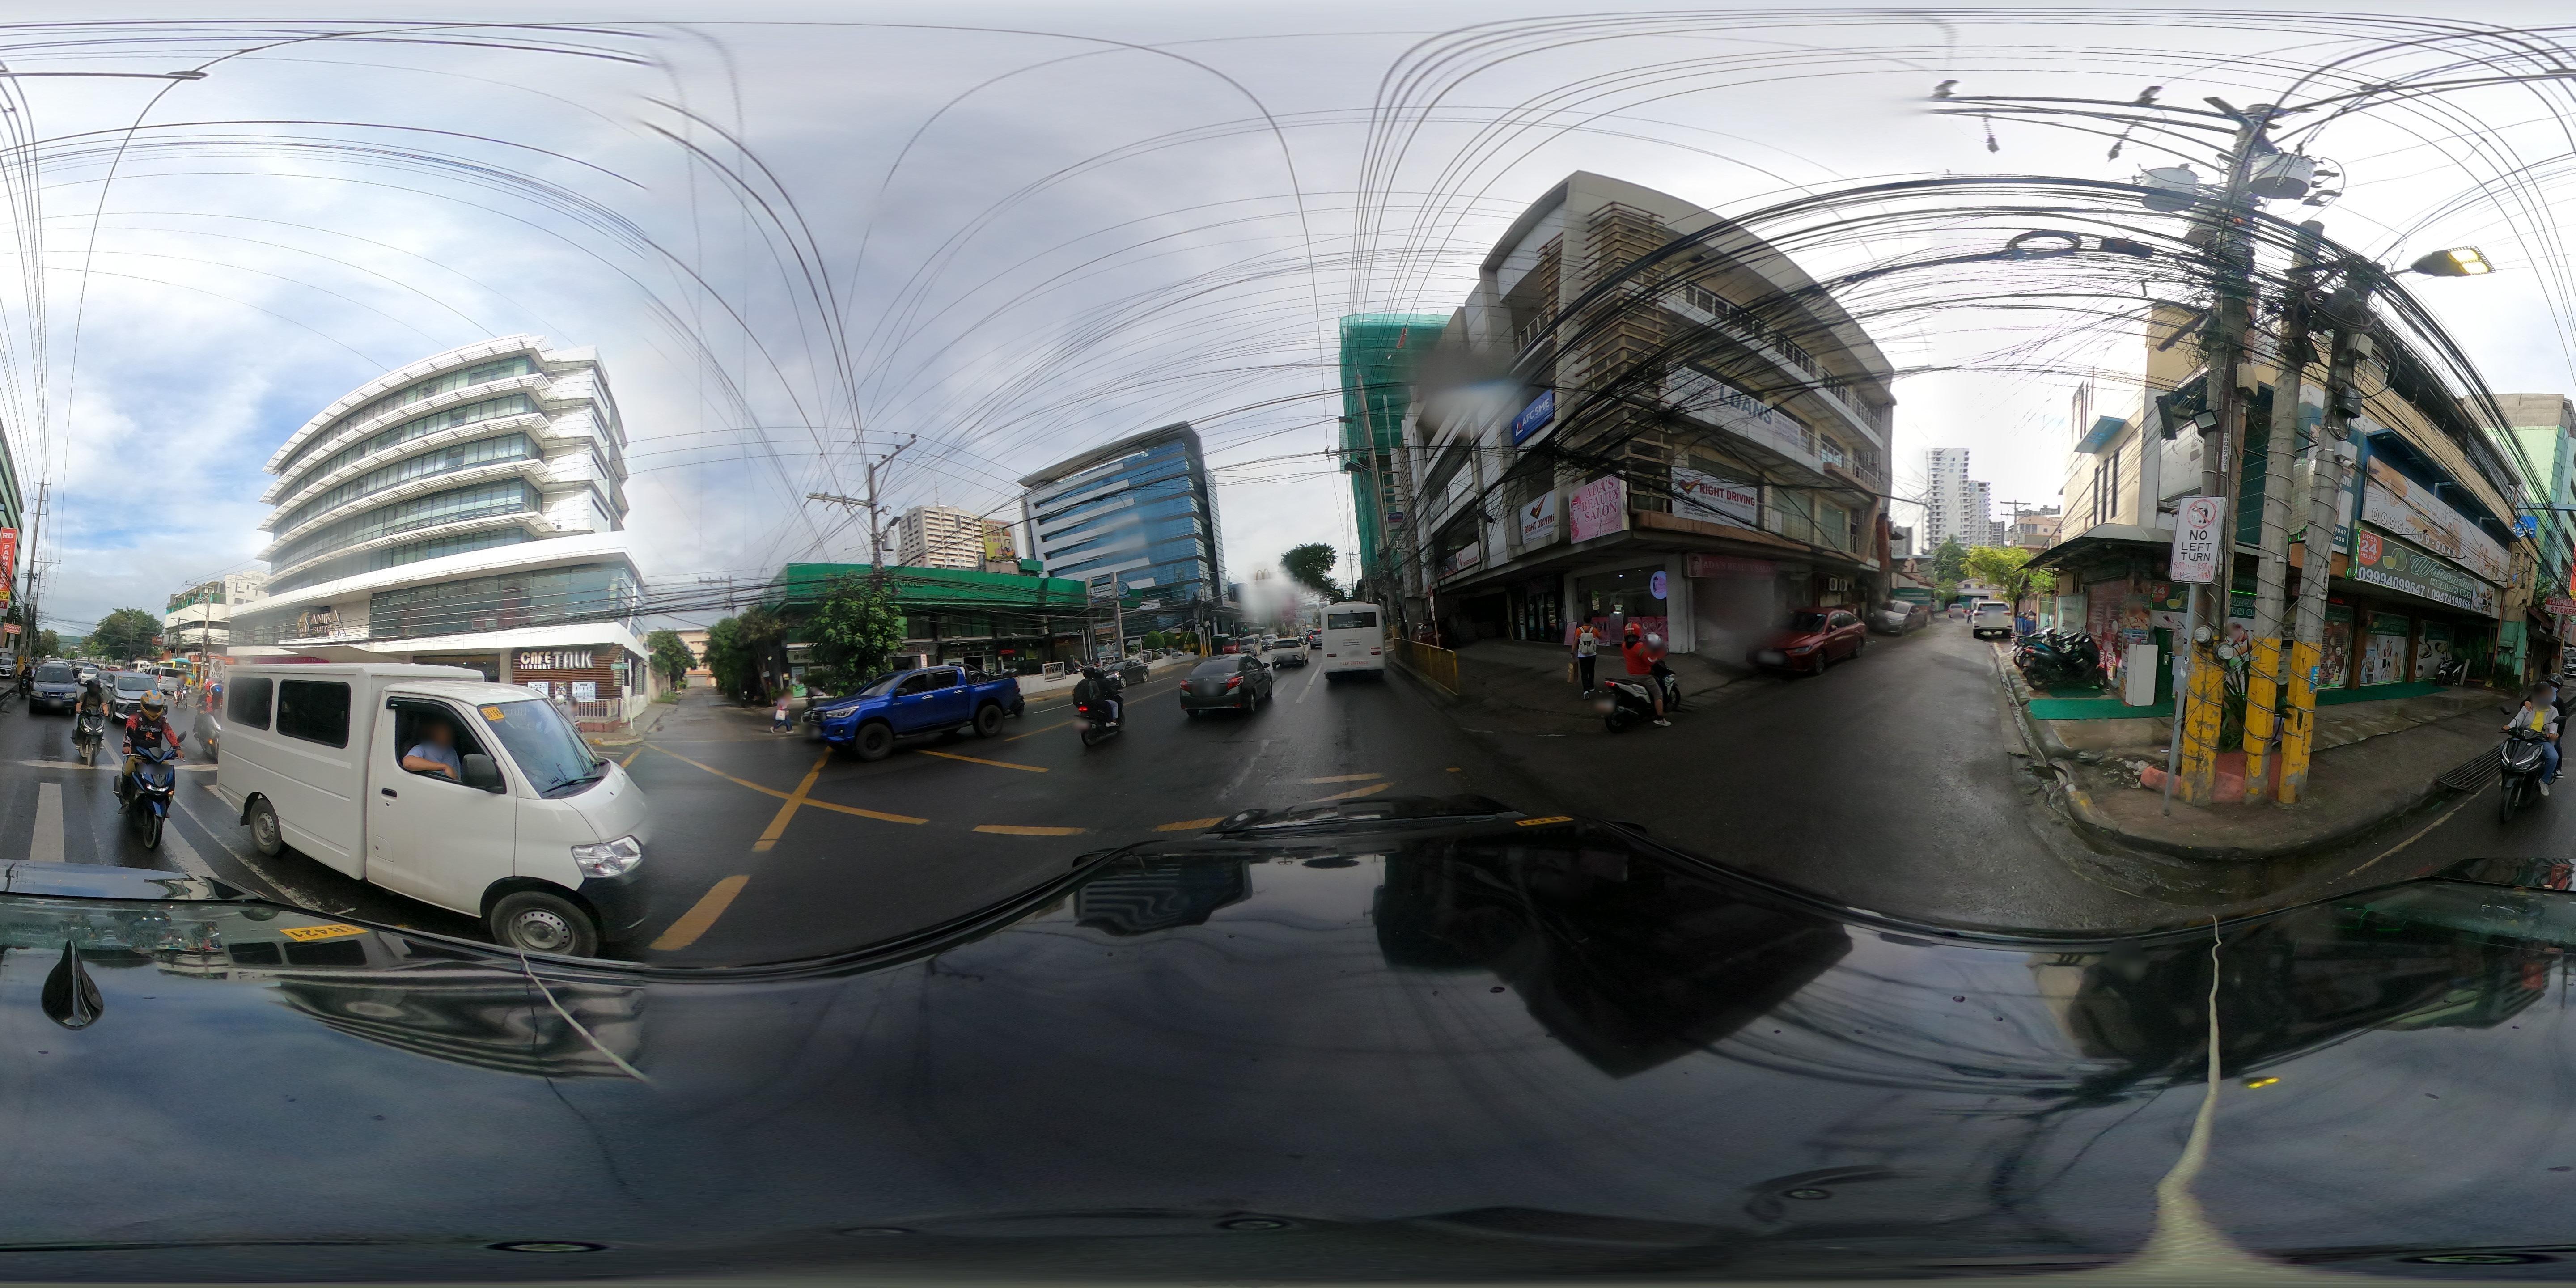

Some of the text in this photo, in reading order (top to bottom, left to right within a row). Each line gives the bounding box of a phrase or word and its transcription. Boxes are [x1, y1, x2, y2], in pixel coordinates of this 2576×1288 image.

[1522, 398, 1550, 427] AFC SME
[1719, 385, 1772, 425] LOANS
[1586, 478, 1614, 499] ADA'S
[1699, 483, 1724, 498] RIGHT
[1726, 490, 1755, 506] DRIVING
[1581, 487, 1620, 512] BEAUTY
[1585, 502, 1617, 522] SALON
[1524, 521, 1536, 534] RIGHT
[2190, 530, 2207, 540] NO
[2362, 534, 2378, 543] OPEN
[2182, 542, 2212, 551] LEFT
[2360, 540, 2377, 555] 24
[2181, 552, 2211, 561] TURN
[2360, 552, 2377, 561] HOURS
[2410, 555, 2472, 591] Watermelon
[2153, 586, 2165, 594] 24
[2358, 567, 2471, 610] 09994099647 09474198456
[2430, 578, 2471, 599] HEALTH SPA
[310, 610, 339, 624] ANIKA
[2551, 606, 2576, 615] STICKER
[313, 624, 335, 633] SUITES
[521, 651, 593, 669] CAFE TALK
